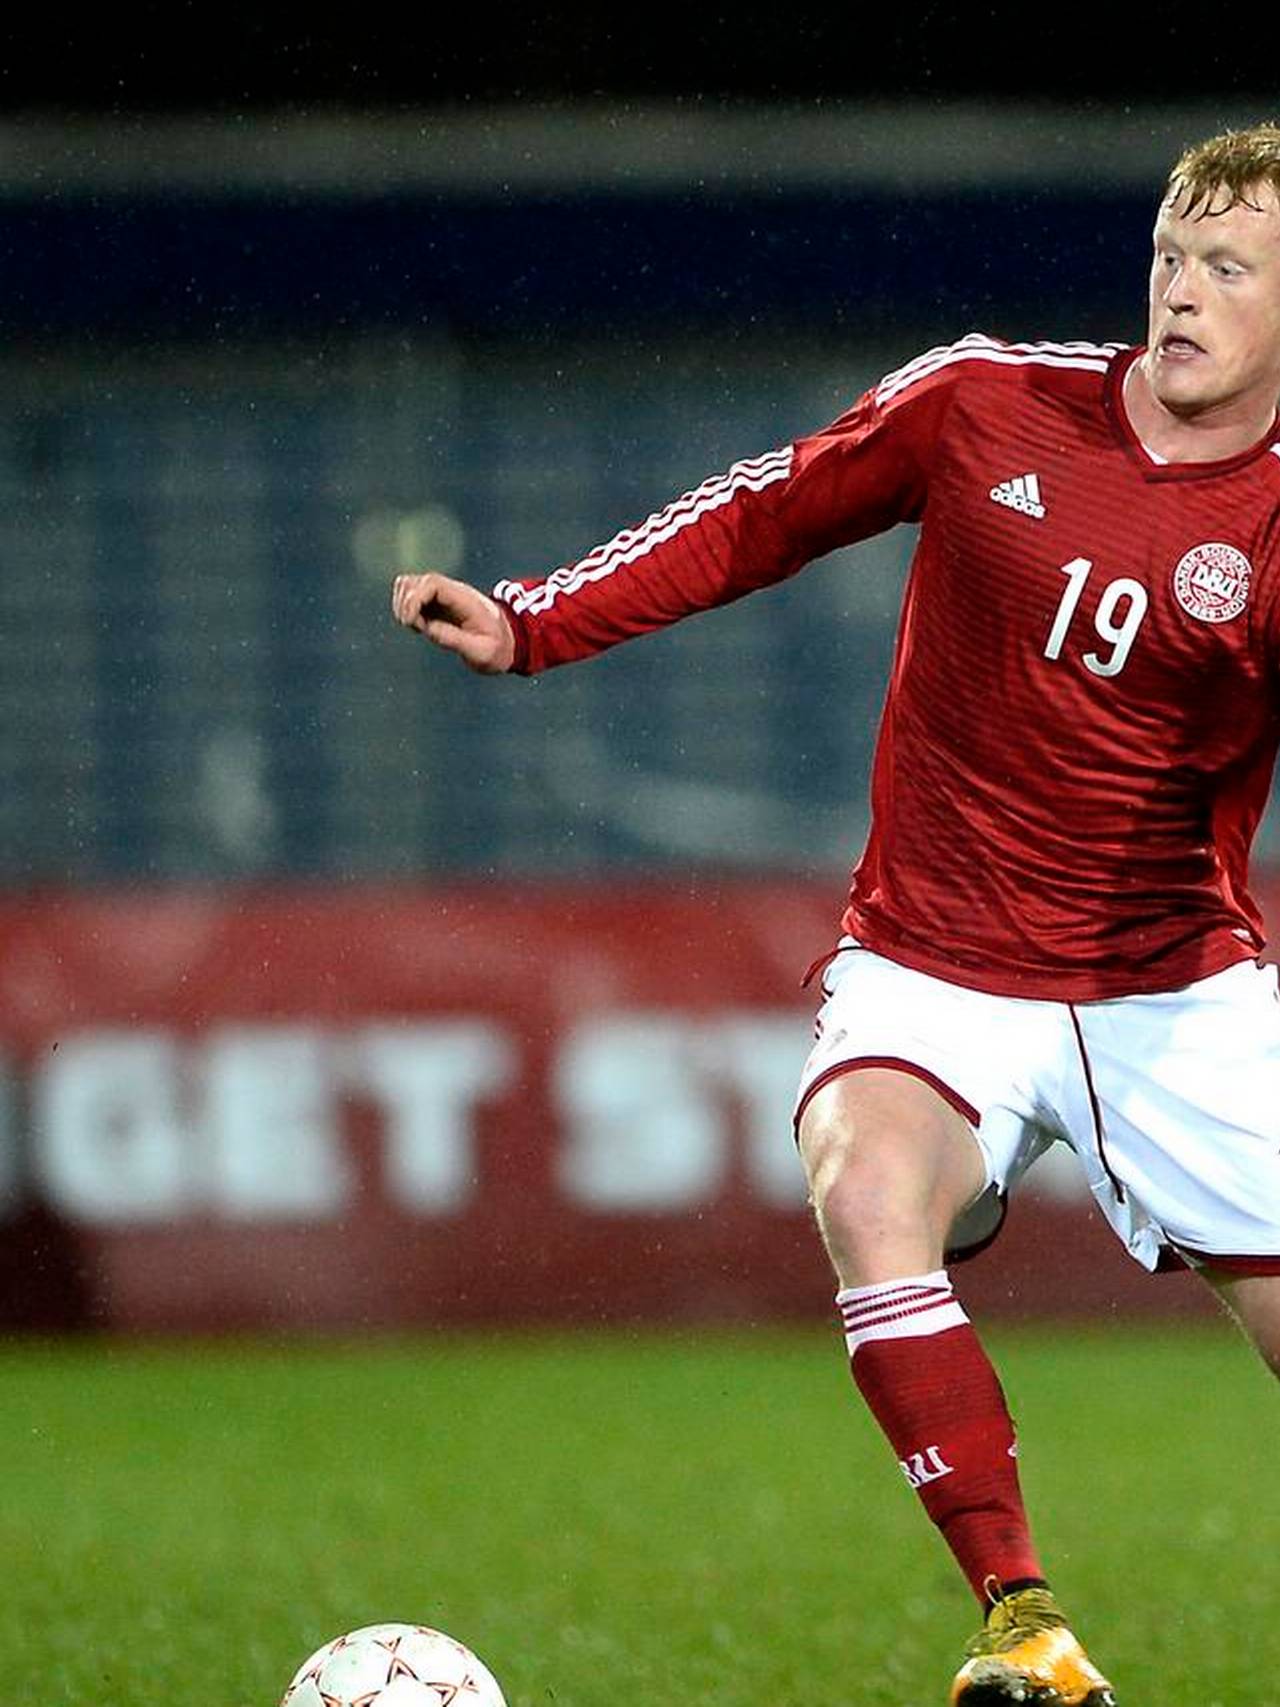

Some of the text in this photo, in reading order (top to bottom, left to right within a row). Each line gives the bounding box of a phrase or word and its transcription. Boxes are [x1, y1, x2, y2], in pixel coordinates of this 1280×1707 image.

[989, 486, 1046, 519] adidas
[1044, 557, 1148, 677] 19
[0, 1024, 510, 1222] GET
